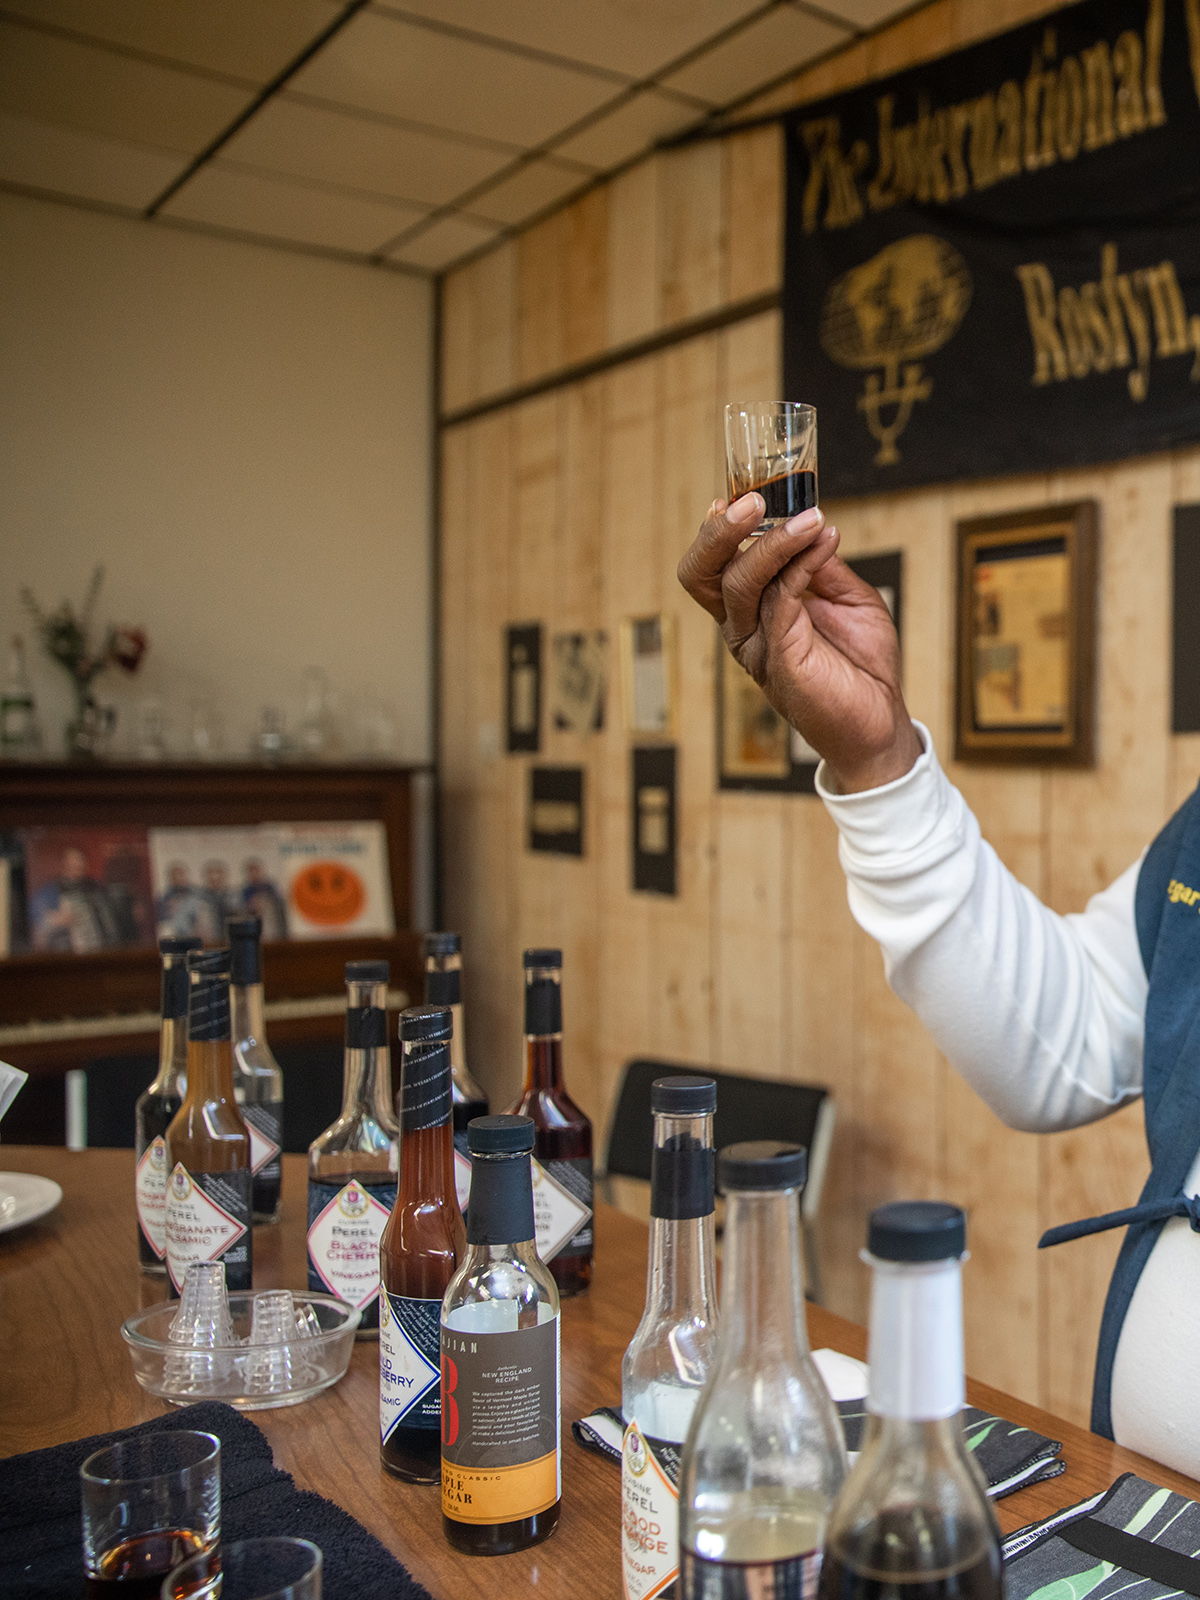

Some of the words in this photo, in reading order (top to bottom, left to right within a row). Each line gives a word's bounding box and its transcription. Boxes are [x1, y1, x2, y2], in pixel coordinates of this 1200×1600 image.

[330, 1240, 378, 1250] BLACK
[326, 1250, 379, 1260] CHERR
[500, 1366, 532, 1378] ENGLAND
